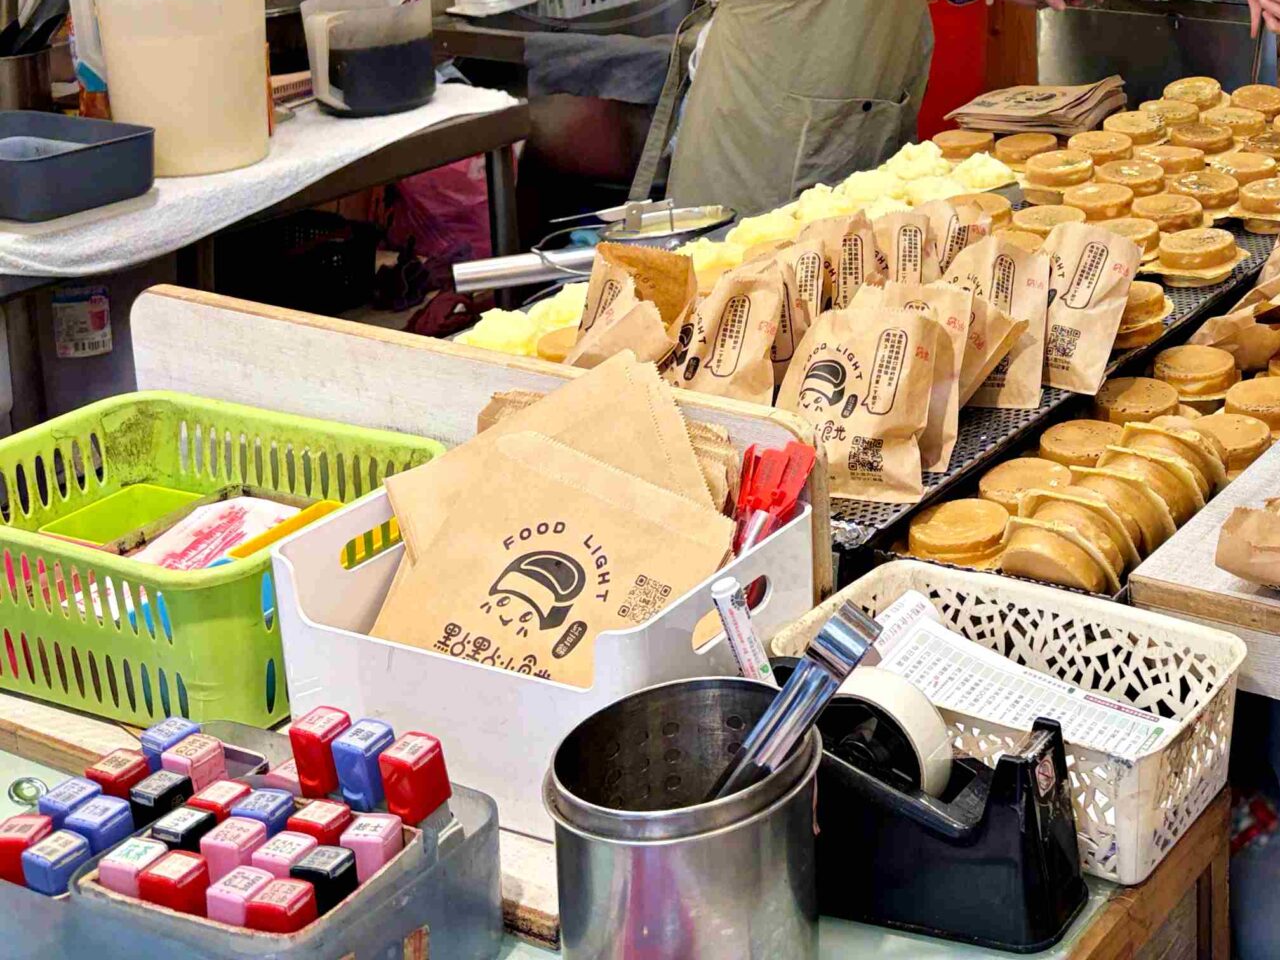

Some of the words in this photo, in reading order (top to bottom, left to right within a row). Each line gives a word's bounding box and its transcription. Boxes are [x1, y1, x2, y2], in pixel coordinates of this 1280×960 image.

[835, 343, 864, 381] LIGHT
[502, 520, 567, 551] FOOD
[582, 533, 611, 603] LIGHT
